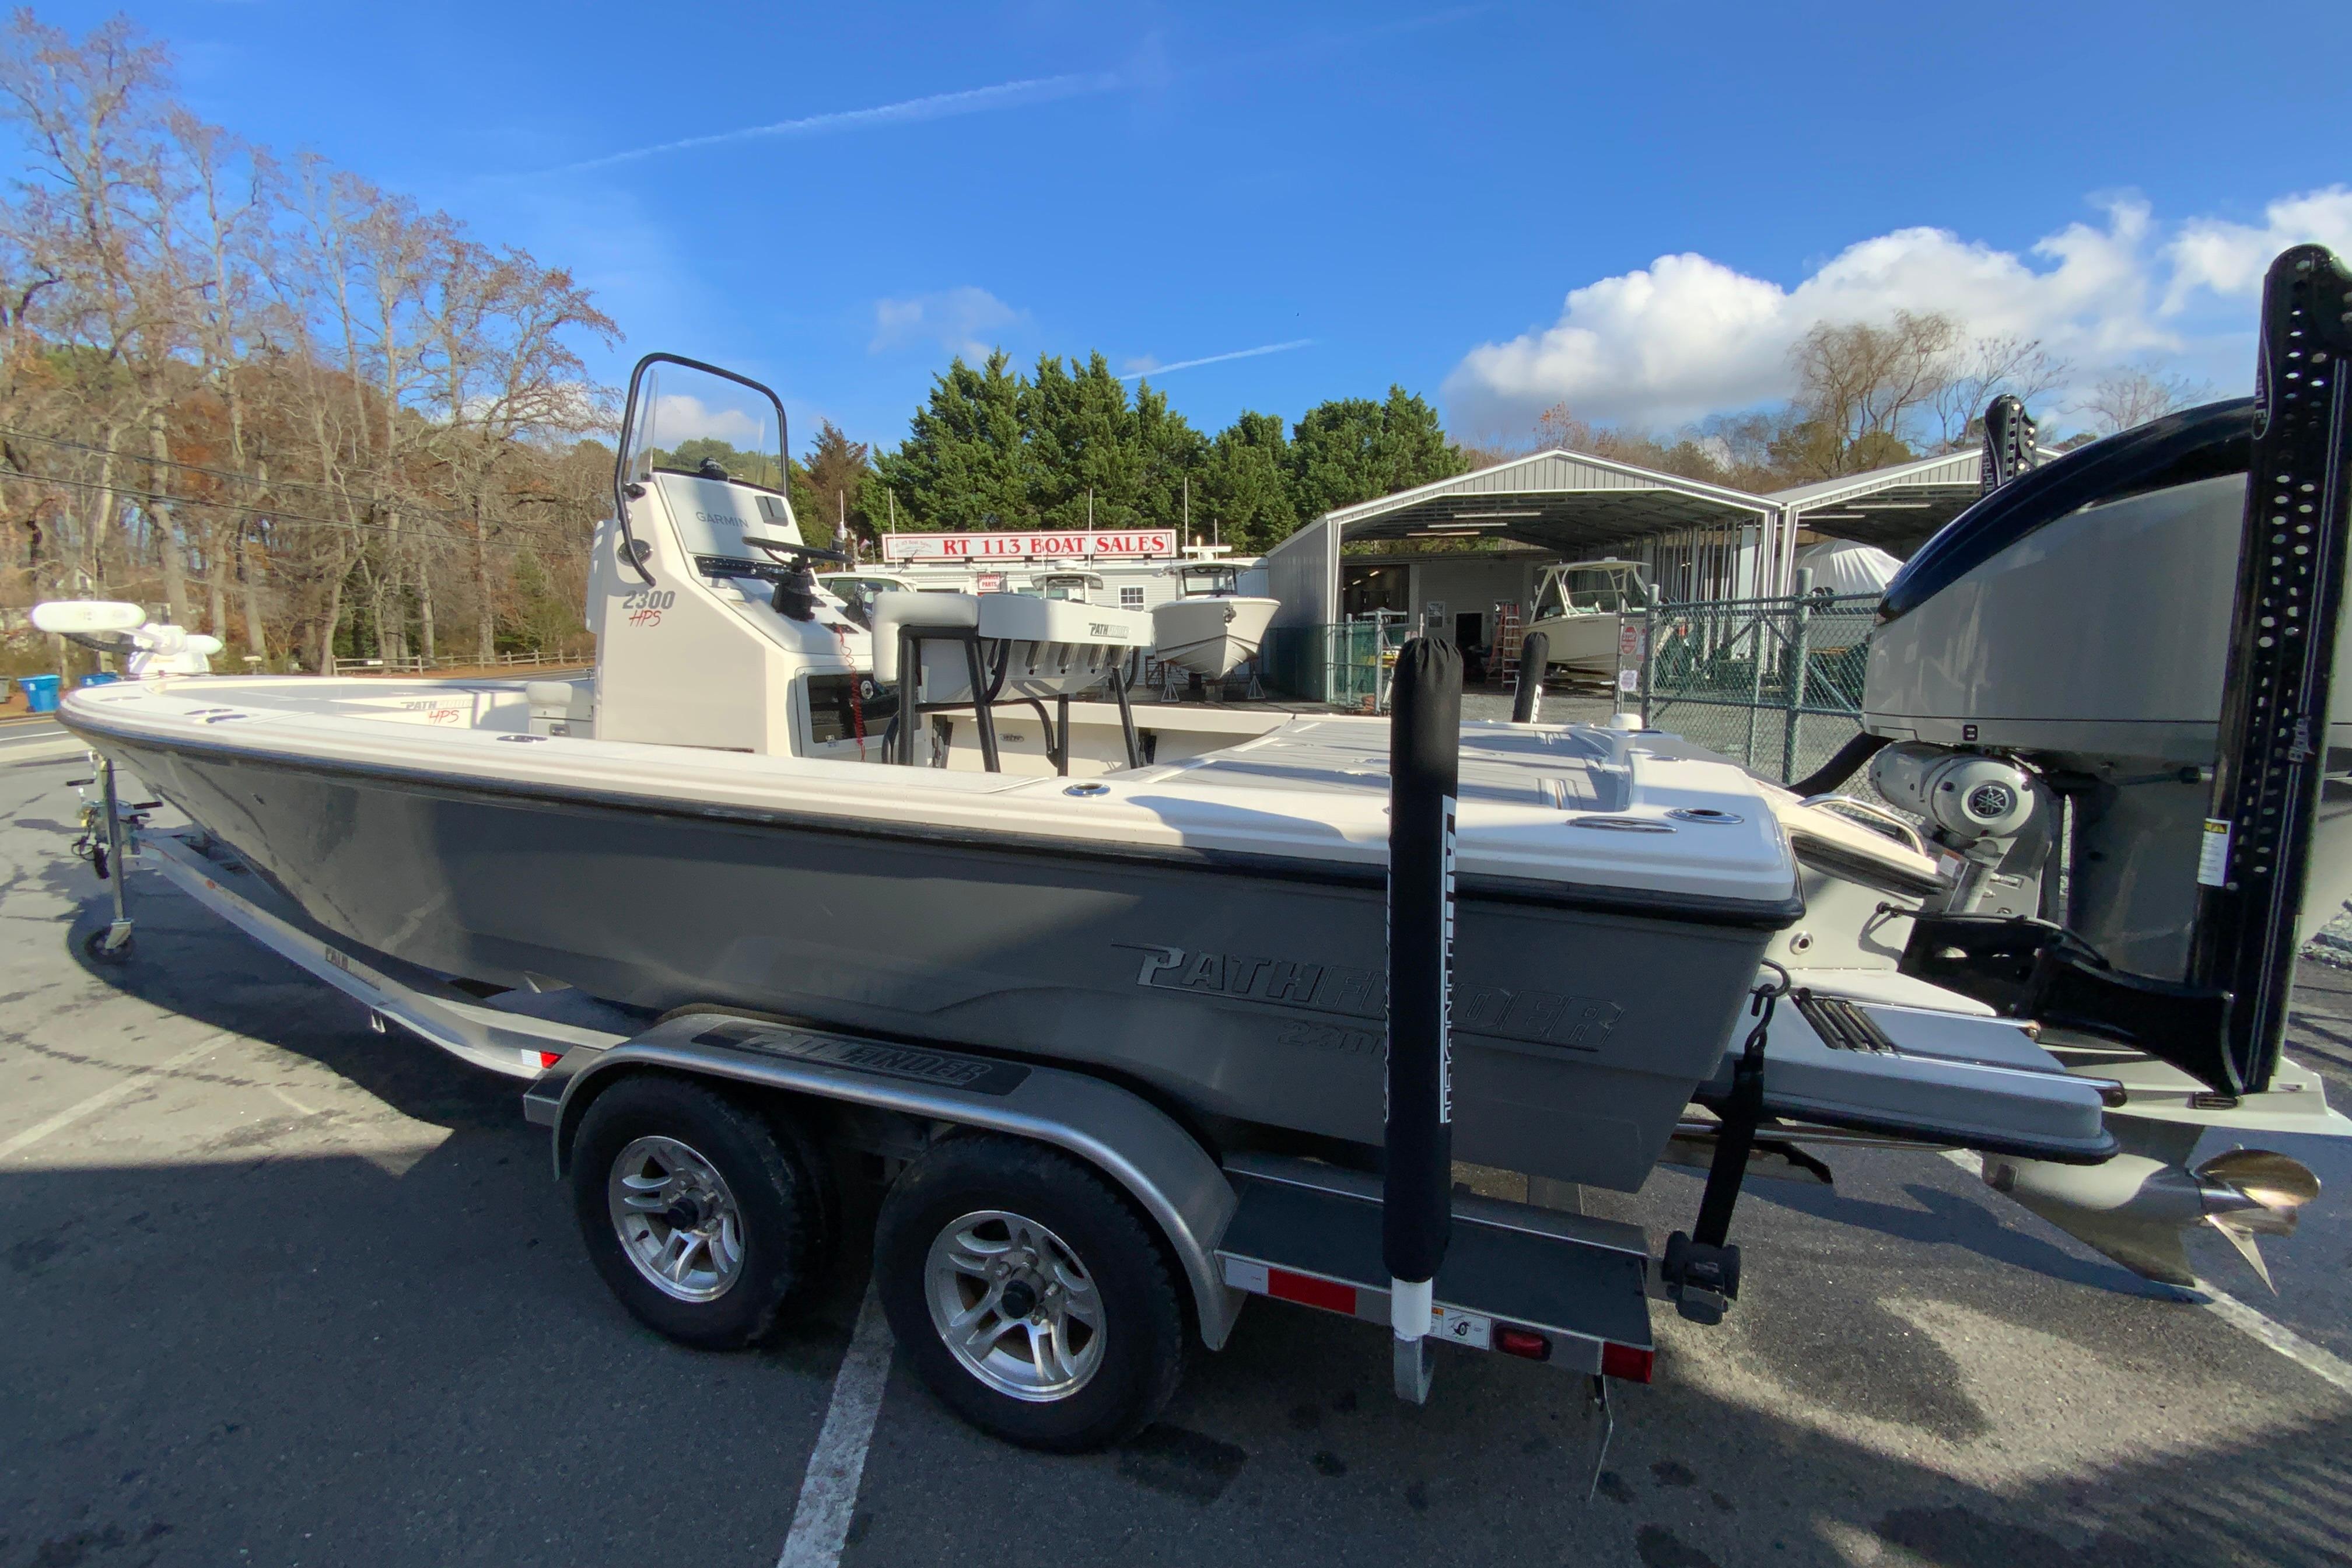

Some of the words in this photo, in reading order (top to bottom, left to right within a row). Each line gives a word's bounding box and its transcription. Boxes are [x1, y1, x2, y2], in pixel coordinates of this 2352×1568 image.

[695, 511, 749, 528] GARMIN
[943, 539, 971, 555] RT
[981, 538, 1021, 554] 113
[1030, 537, 1086, 554] BOAT
[1097, 536, 1165, 552] SALES
[622, 590, 676, 610] 2300
[629, 610, 662, 627] HPS
[1111, 940, 1625, 1052] PATHFIDER
